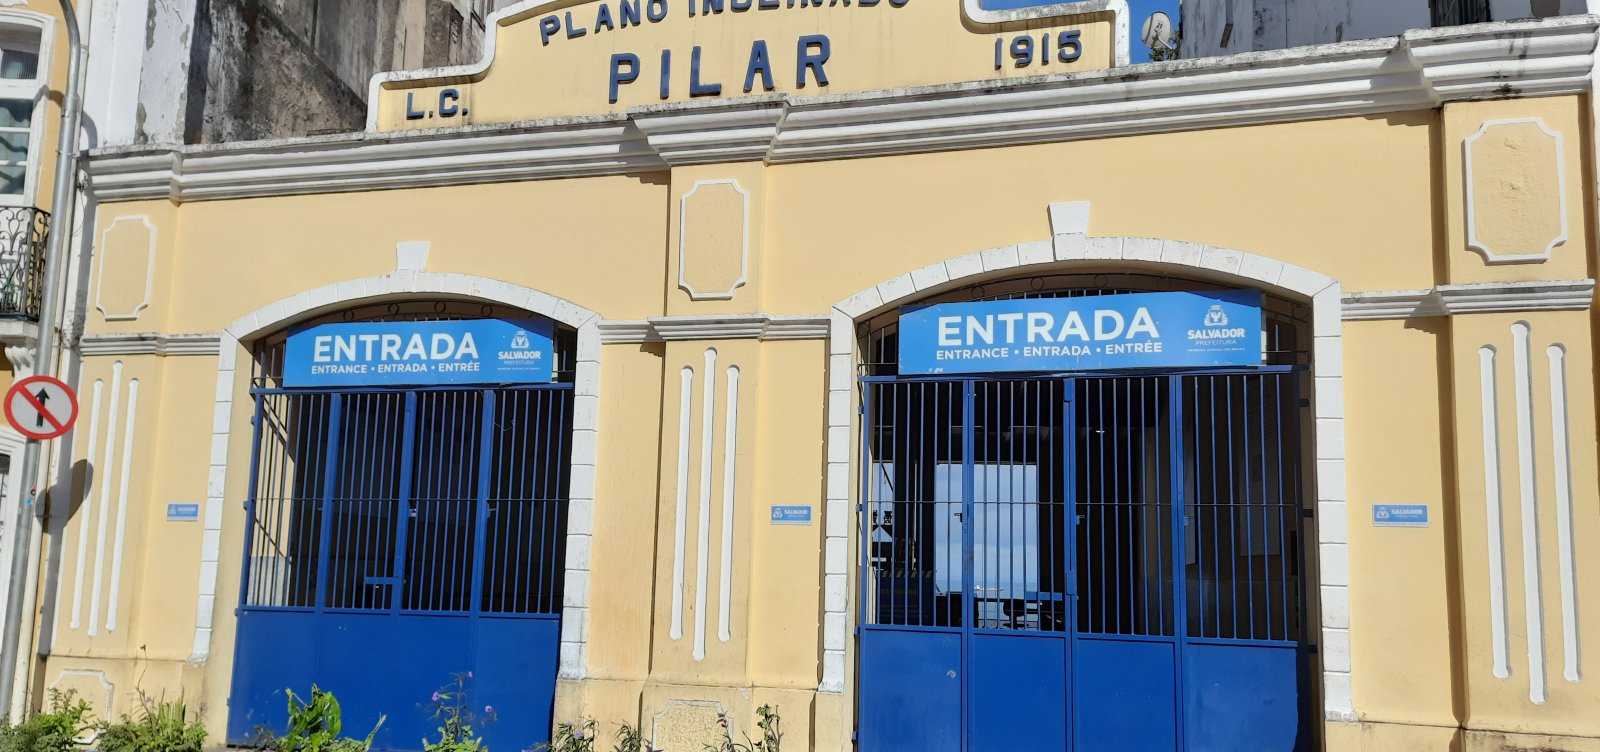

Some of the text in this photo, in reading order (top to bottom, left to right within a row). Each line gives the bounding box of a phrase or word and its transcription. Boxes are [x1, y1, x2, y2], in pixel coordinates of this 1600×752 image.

[539, 0, 668, 47] PLANO
[994, 29, 1083, 71] 1915
[608, 34, 831, 104] PILAR
[406, 88, 469, 120] L.C.
[937, 307, 1160, 346] ENTRADA
[1187, 328, 1246, 340] SALVADOR
[313, 332, 479, 362] ENTRADA
[498, 350, 542, 360] SALVADOR
[936, 339, 1163, 361] ENTRANCE ENTRADA ENTRÉE
[311, 360, 481, 375] ENTRANCE ENTRADA ENTRÉE
